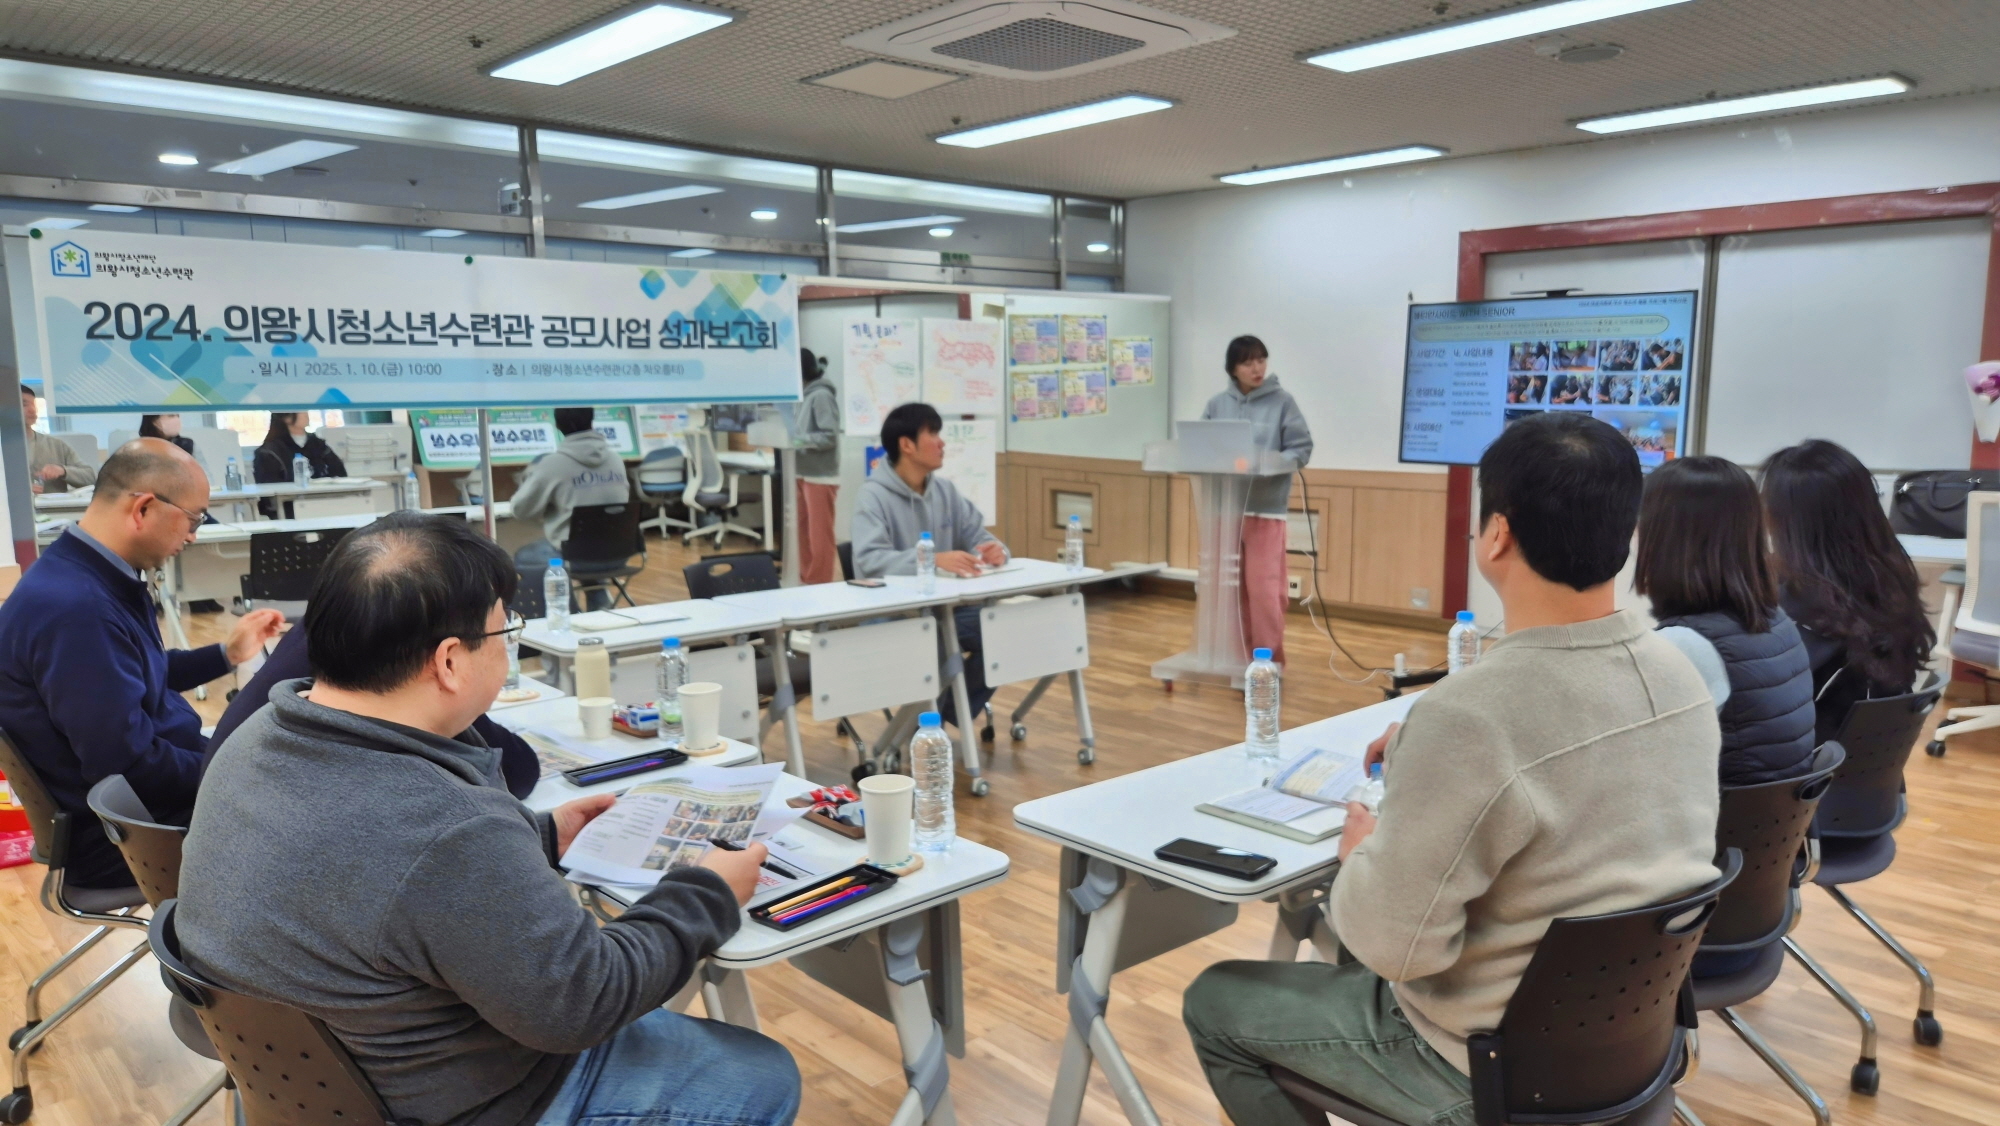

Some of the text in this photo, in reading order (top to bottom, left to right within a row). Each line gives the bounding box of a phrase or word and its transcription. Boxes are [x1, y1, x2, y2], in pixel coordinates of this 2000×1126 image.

[94, 252, 157, 264] 의왕시청소년재단
[96, 264, 195, 281] 의왕시청소년수련관
[1483, 306, 1516, 317] SENIOR
[83, 300, 778, 350] 2024. 의왕시청소년수련관 공모사업 성과보고회
[1463, 347, 1494, 358] 사업내용
[304, 362, 342, 376] 2025.
[347, 363, 357, 376] 1.
[361, 362, 404, 377] 10.(금)
[408, 363, 442, 376] 10:00
